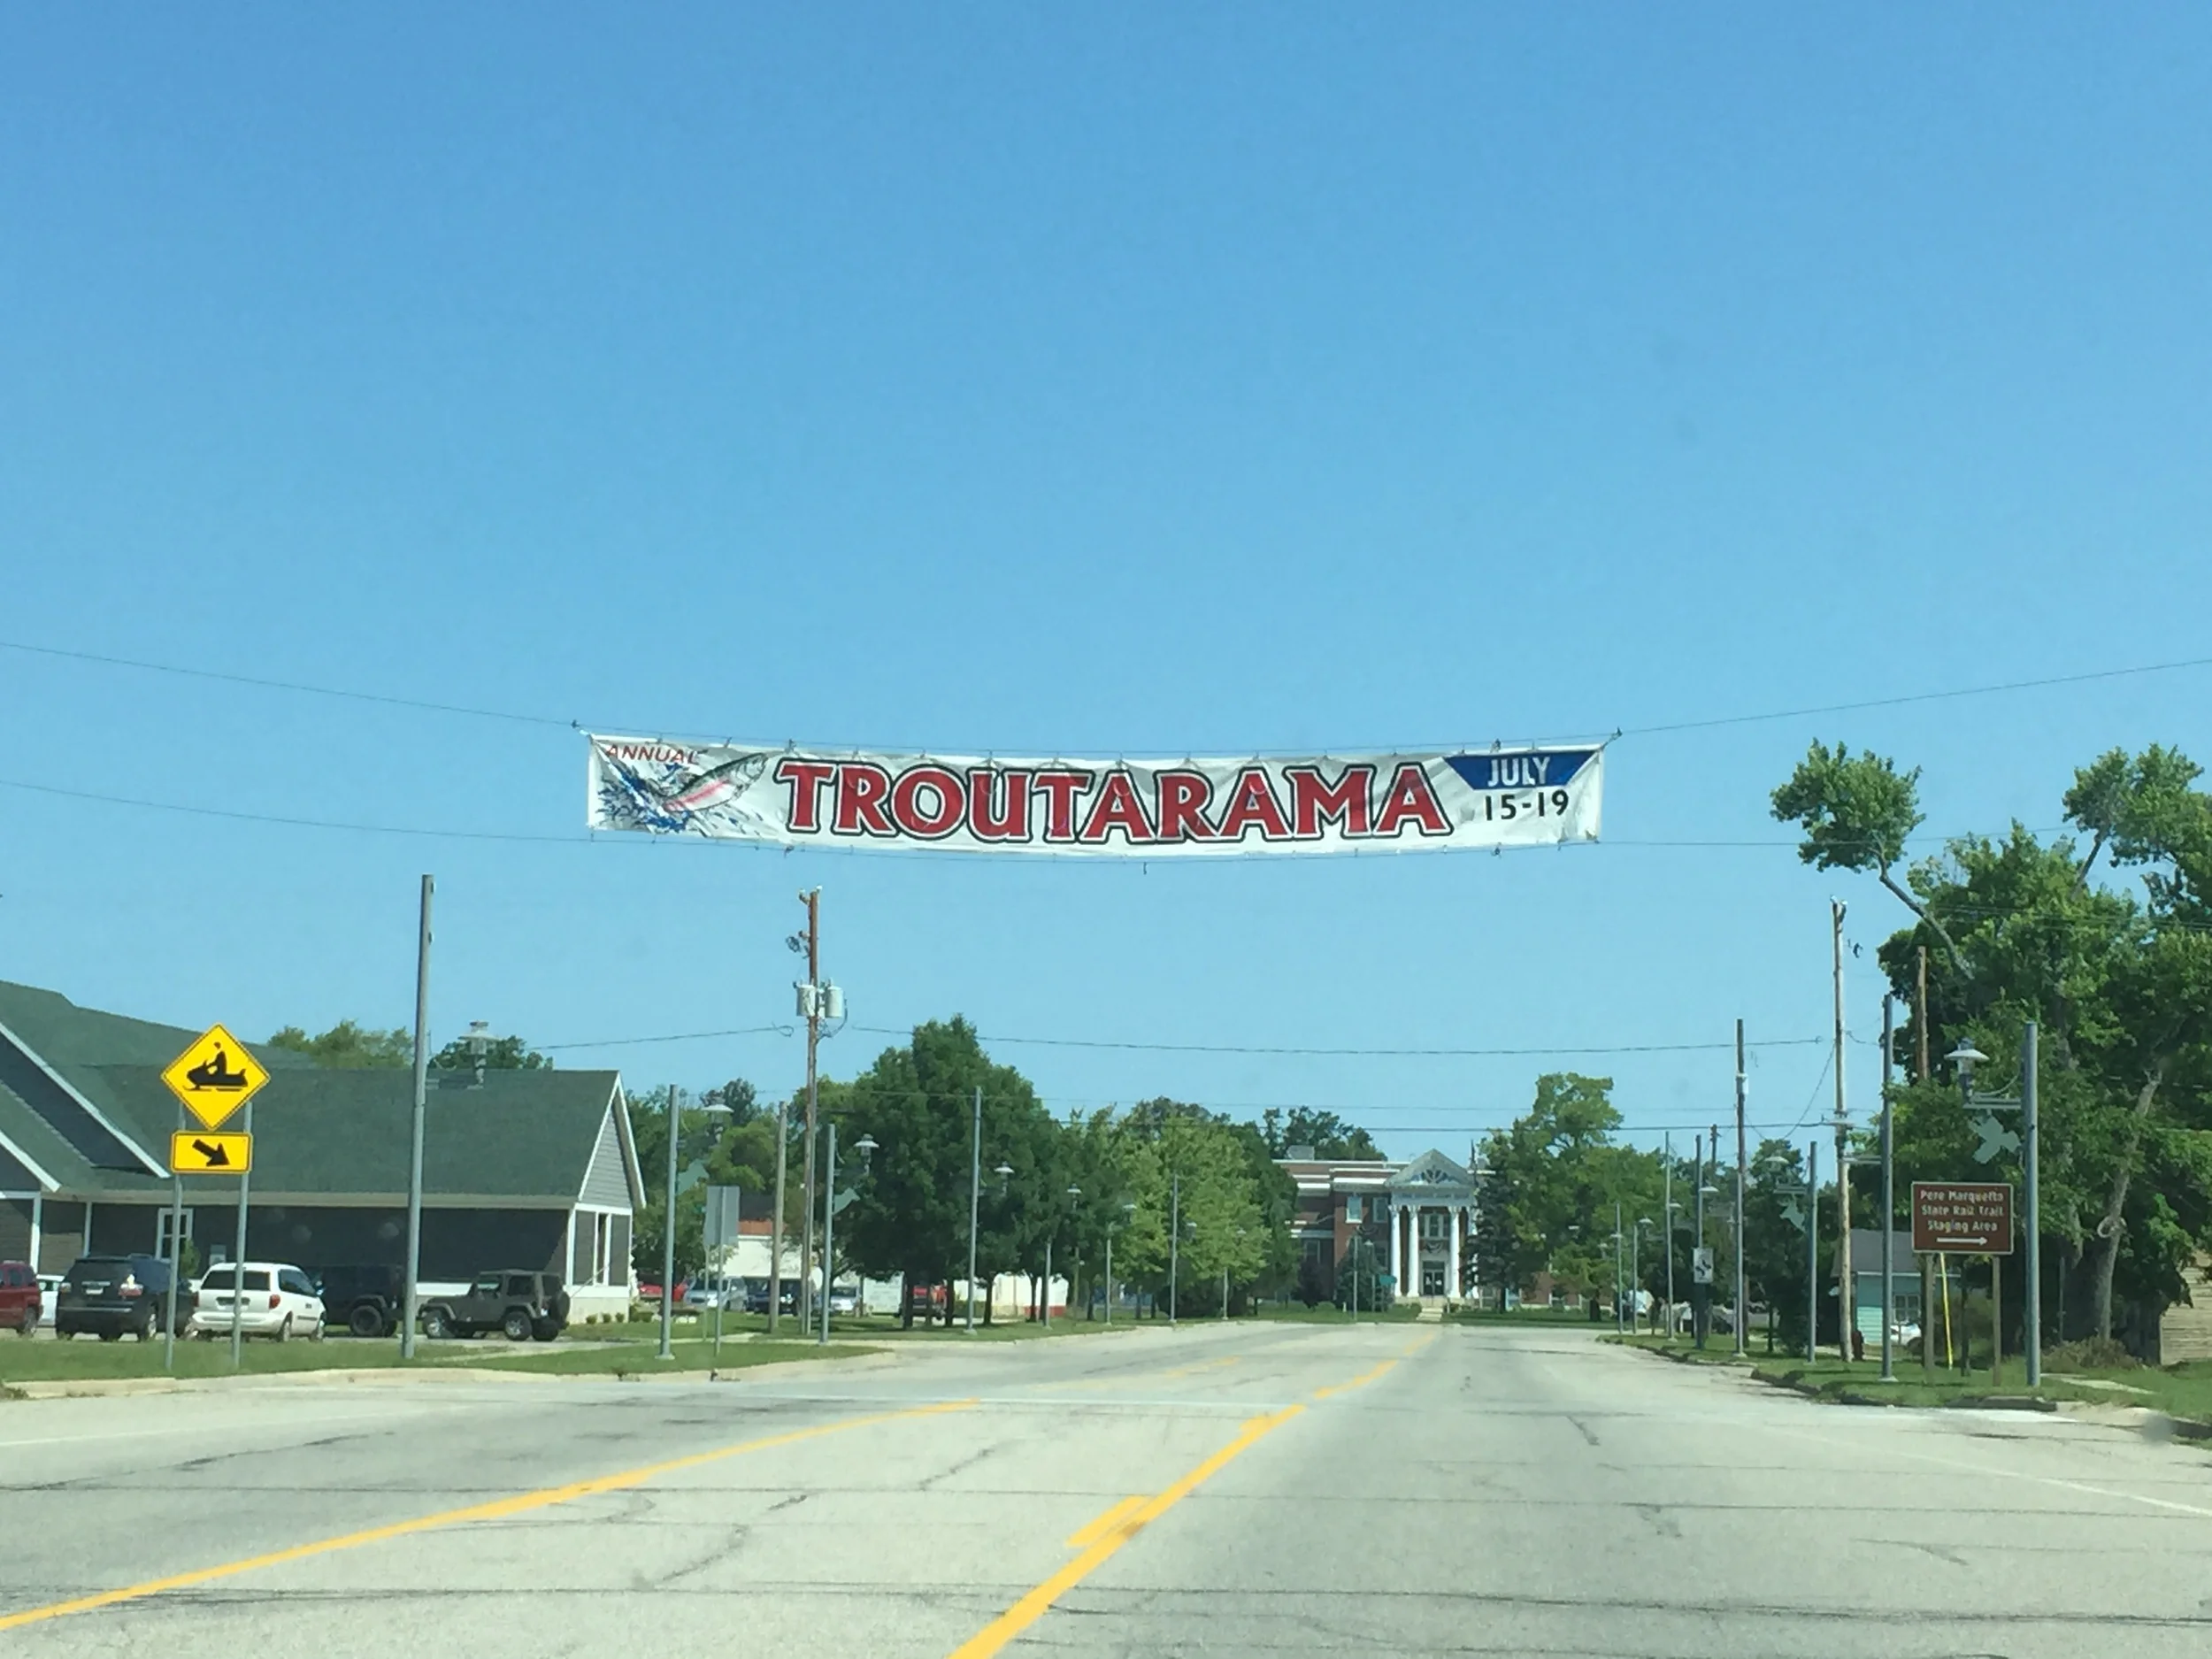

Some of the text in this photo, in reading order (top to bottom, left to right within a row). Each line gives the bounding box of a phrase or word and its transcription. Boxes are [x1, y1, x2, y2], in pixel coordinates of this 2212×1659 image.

[605, 744, 699, 765] ANNUAL
[1487, 757, 1551, 787] JULY
[772, 757, 1454, 844] TROUTARAMA
[1485, 789, 1569, 821] 15-19
[1920, 1189, 2004, 1203] Pere Marquette
[1921, 1204, 2004, 1217] State Rail Trail
[1927, 1219, 1998, 1233] Staging Area
